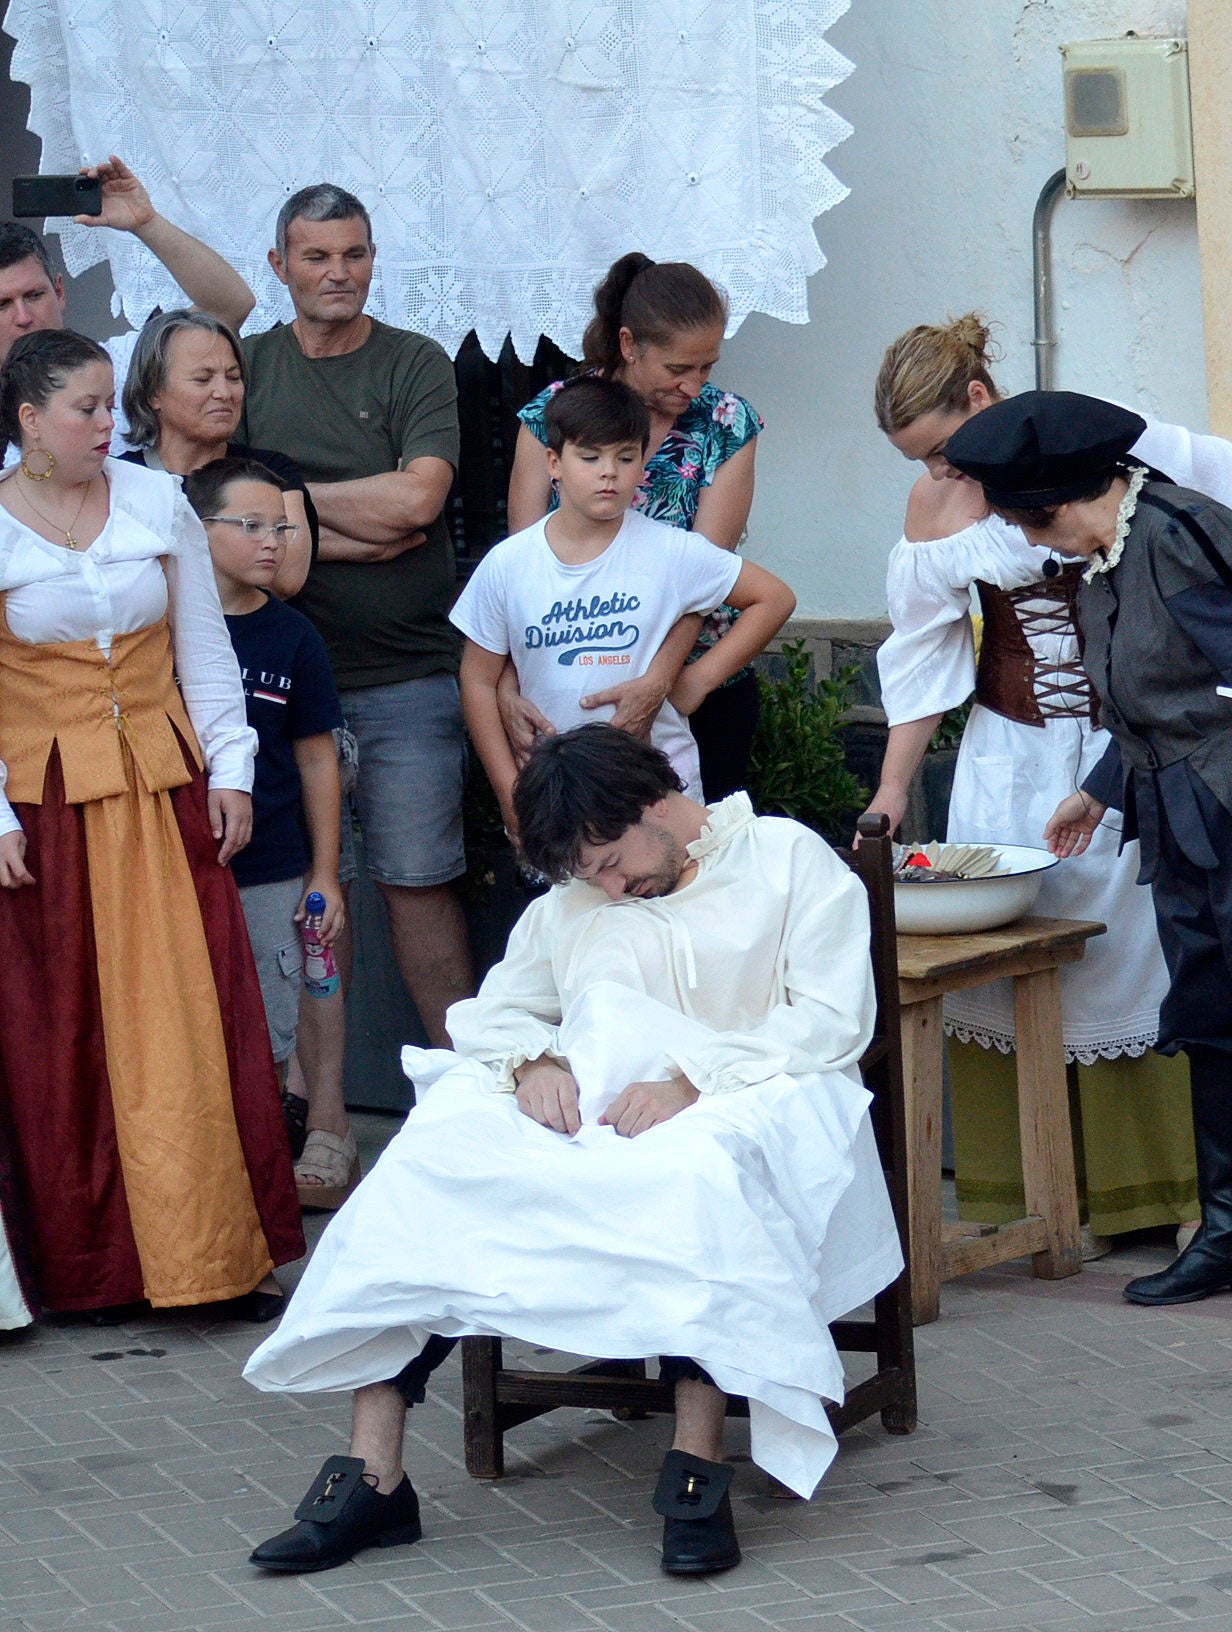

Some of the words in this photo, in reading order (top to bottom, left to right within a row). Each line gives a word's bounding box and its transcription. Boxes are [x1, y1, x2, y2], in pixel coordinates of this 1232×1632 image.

[541, 592, 641, 625] Athletic
[525, 620, 629, 649] Division
[578, 655, 594, 666] LOS
[597, 655, 631, 666] ANGELES
[241, 667, 292, 690] LUB
